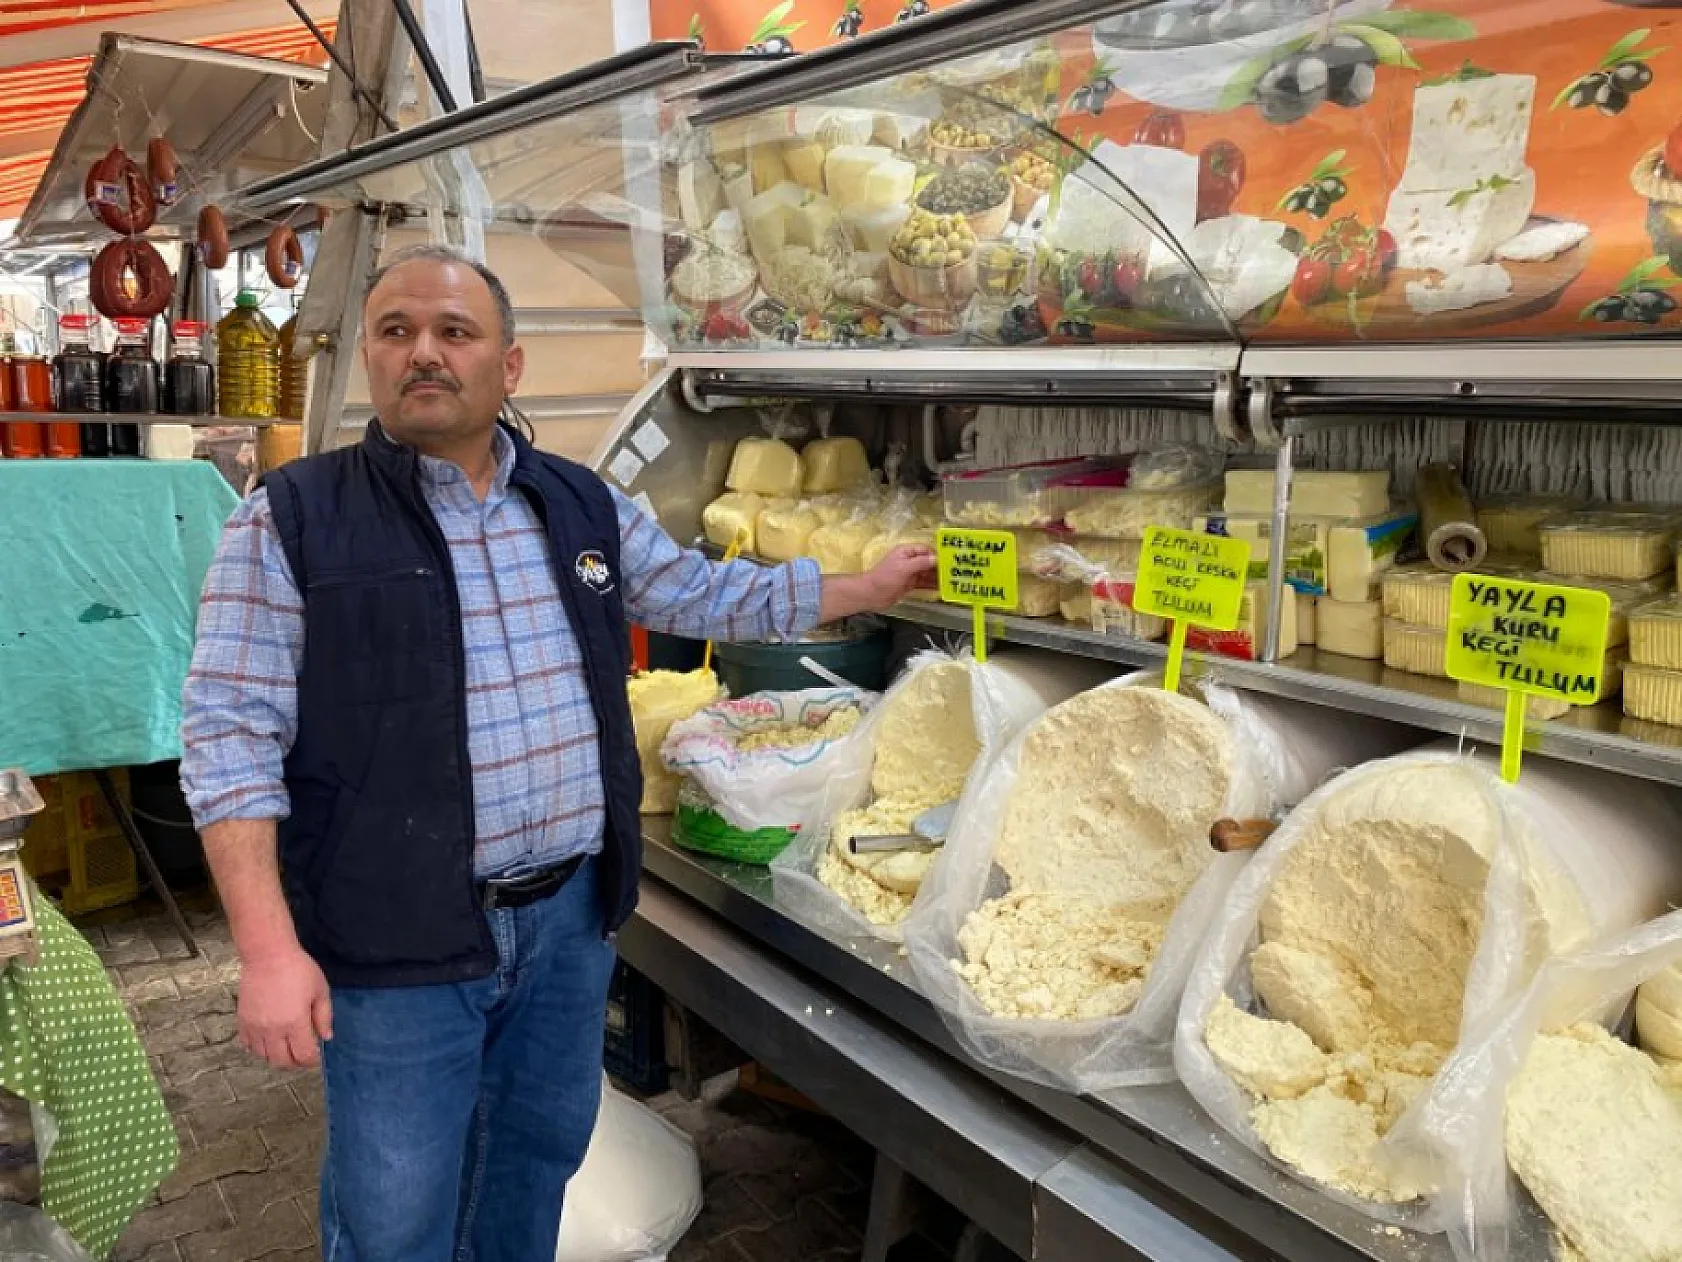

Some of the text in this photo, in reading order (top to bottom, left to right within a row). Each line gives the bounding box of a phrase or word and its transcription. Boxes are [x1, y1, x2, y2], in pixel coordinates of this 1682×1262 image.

[1151, 531, 1219, 558] ELMALI
[949, 580, 1006, 600] TULUM
[1151, 589, 1212, 617] TULUM
[1468, 581, 1567, 618] YAYLA
[1493, 615, 1561, 643] KURU
[1495, 660, 1596, 694] TULUM
